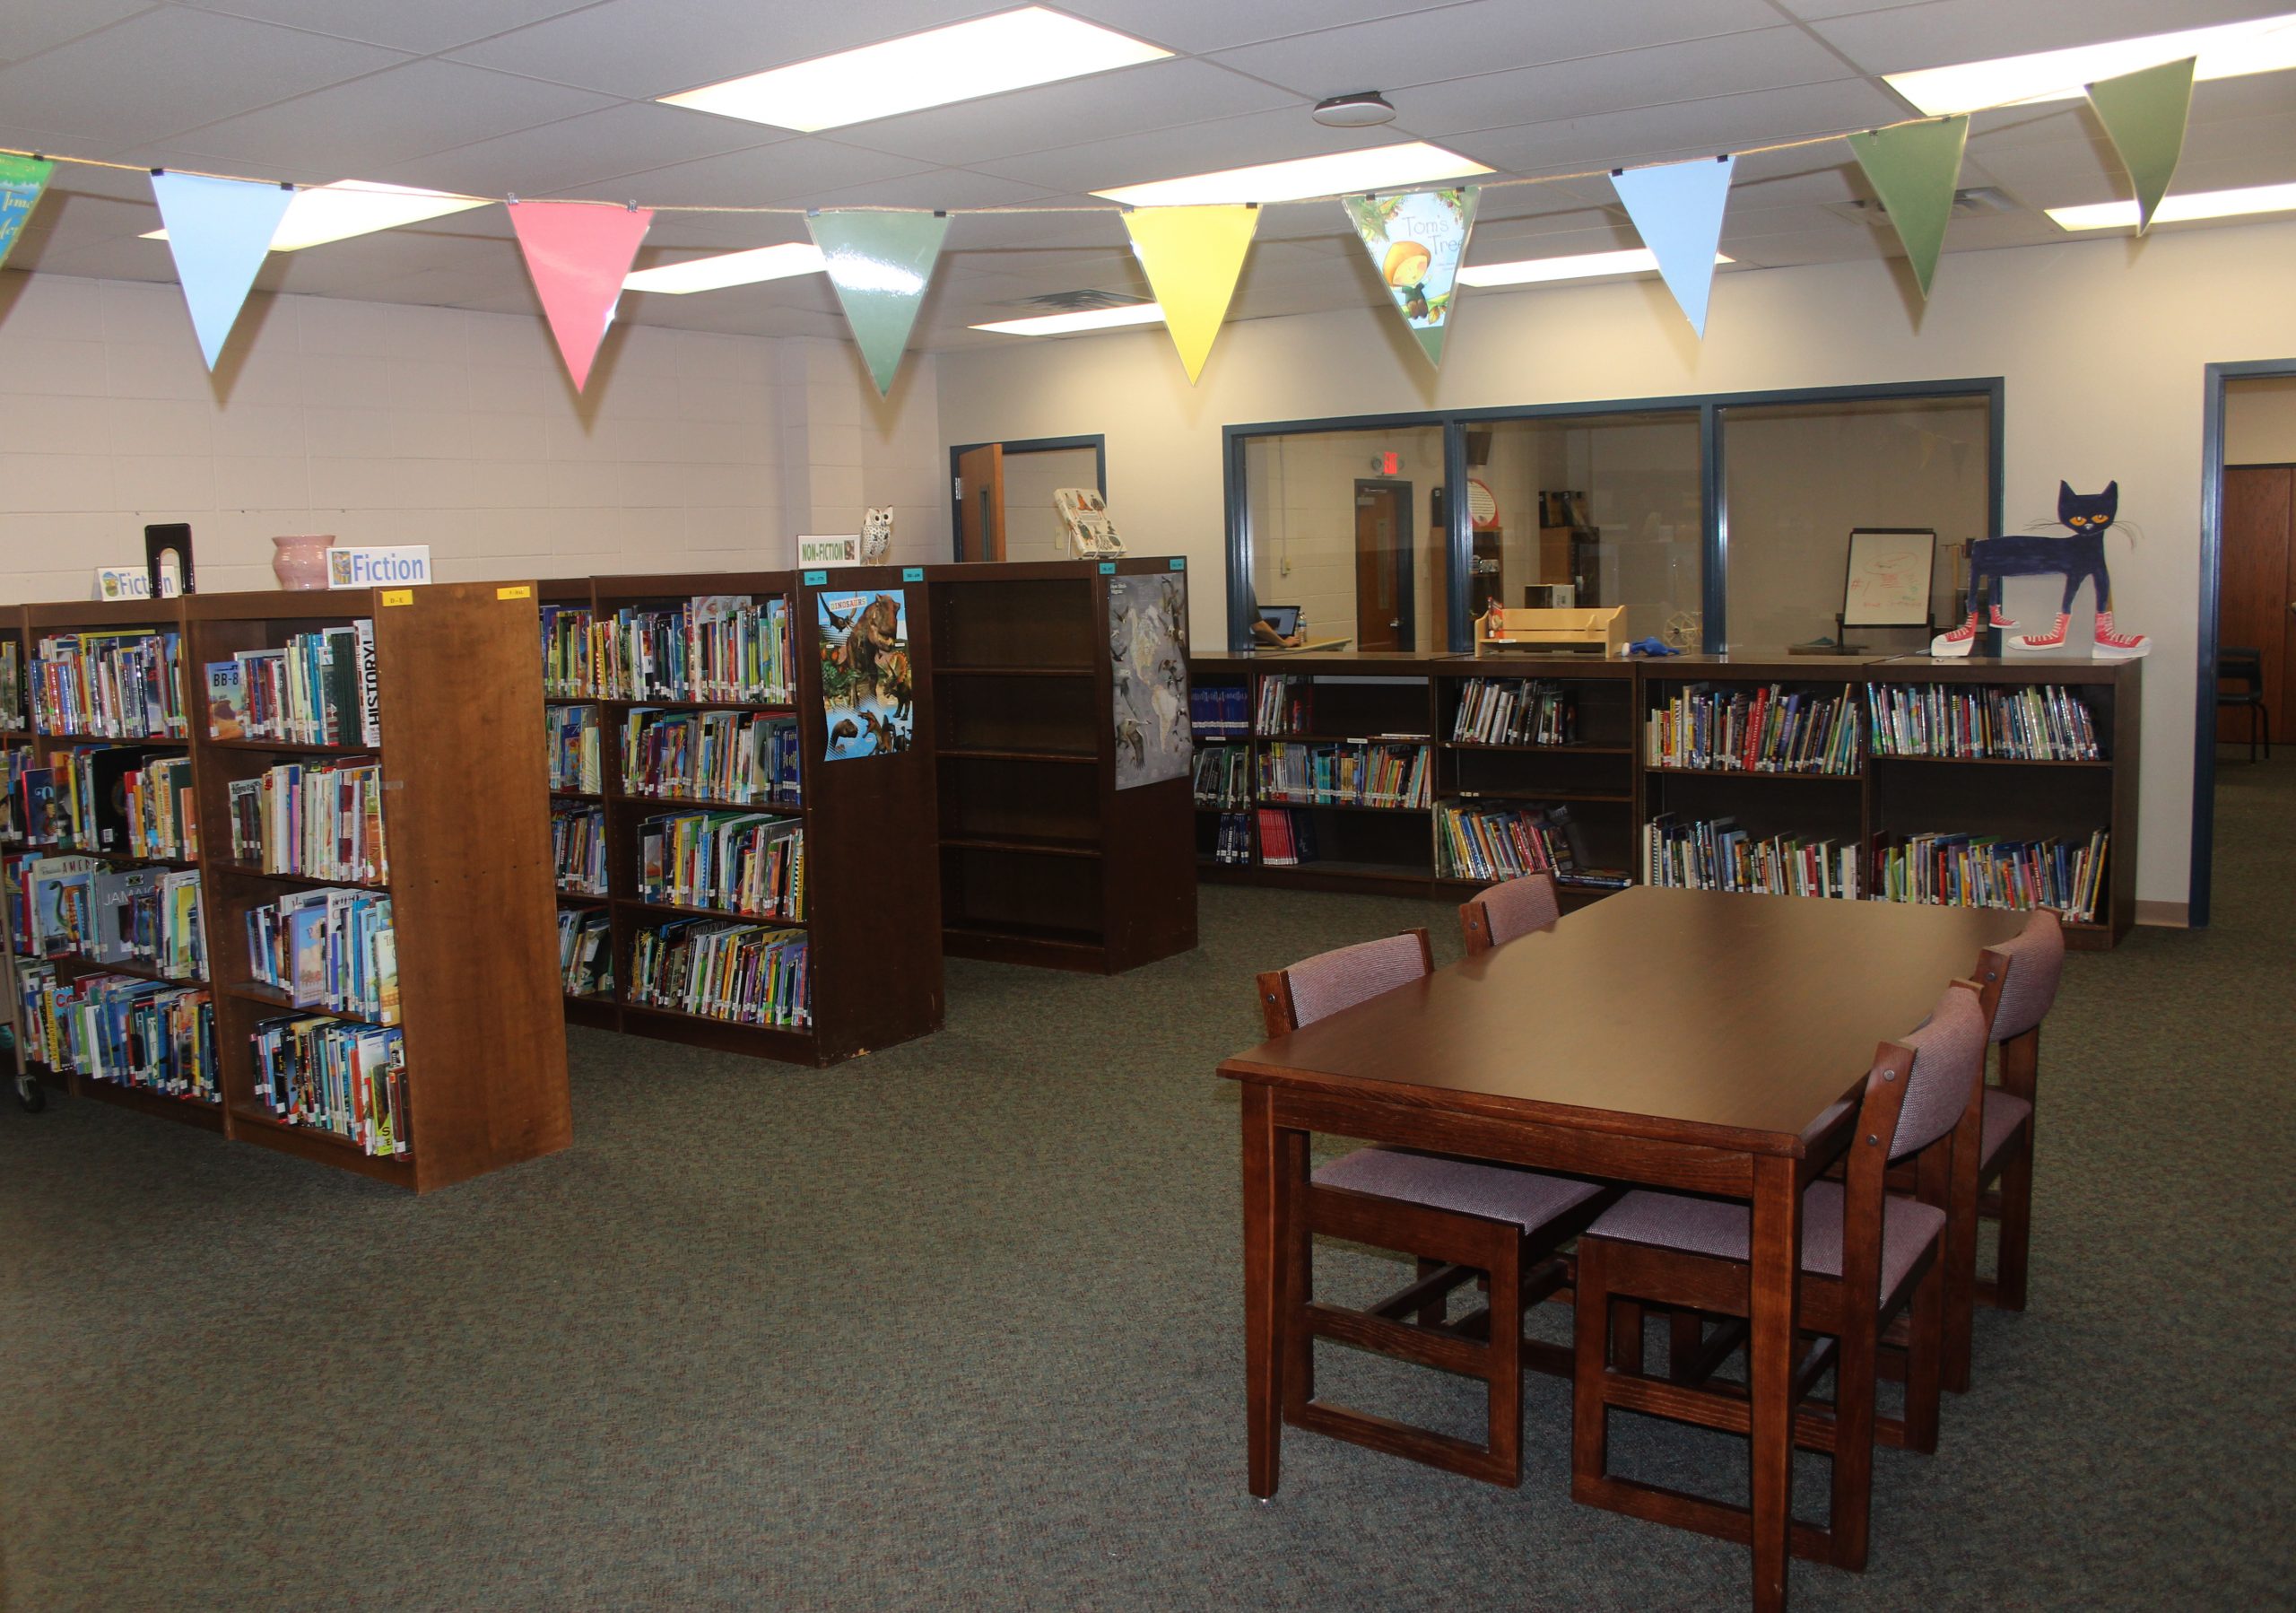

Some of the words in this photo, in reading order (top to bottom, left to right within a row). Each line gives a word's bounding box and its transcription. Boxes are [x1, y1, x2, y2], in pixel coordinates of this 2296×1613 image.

[1402, 214, 1449, 237] Tom's
[802, 543, 843, 562] NON-FICTION
[353, 553, 424, 581] Fiction
[118, 572, 173, 595] Fictn
[831, 598, 866, 610] DINOSAURS
[213, 673, 239, 686] BB-8
[363, 640, 380, 726] HISTORY!
